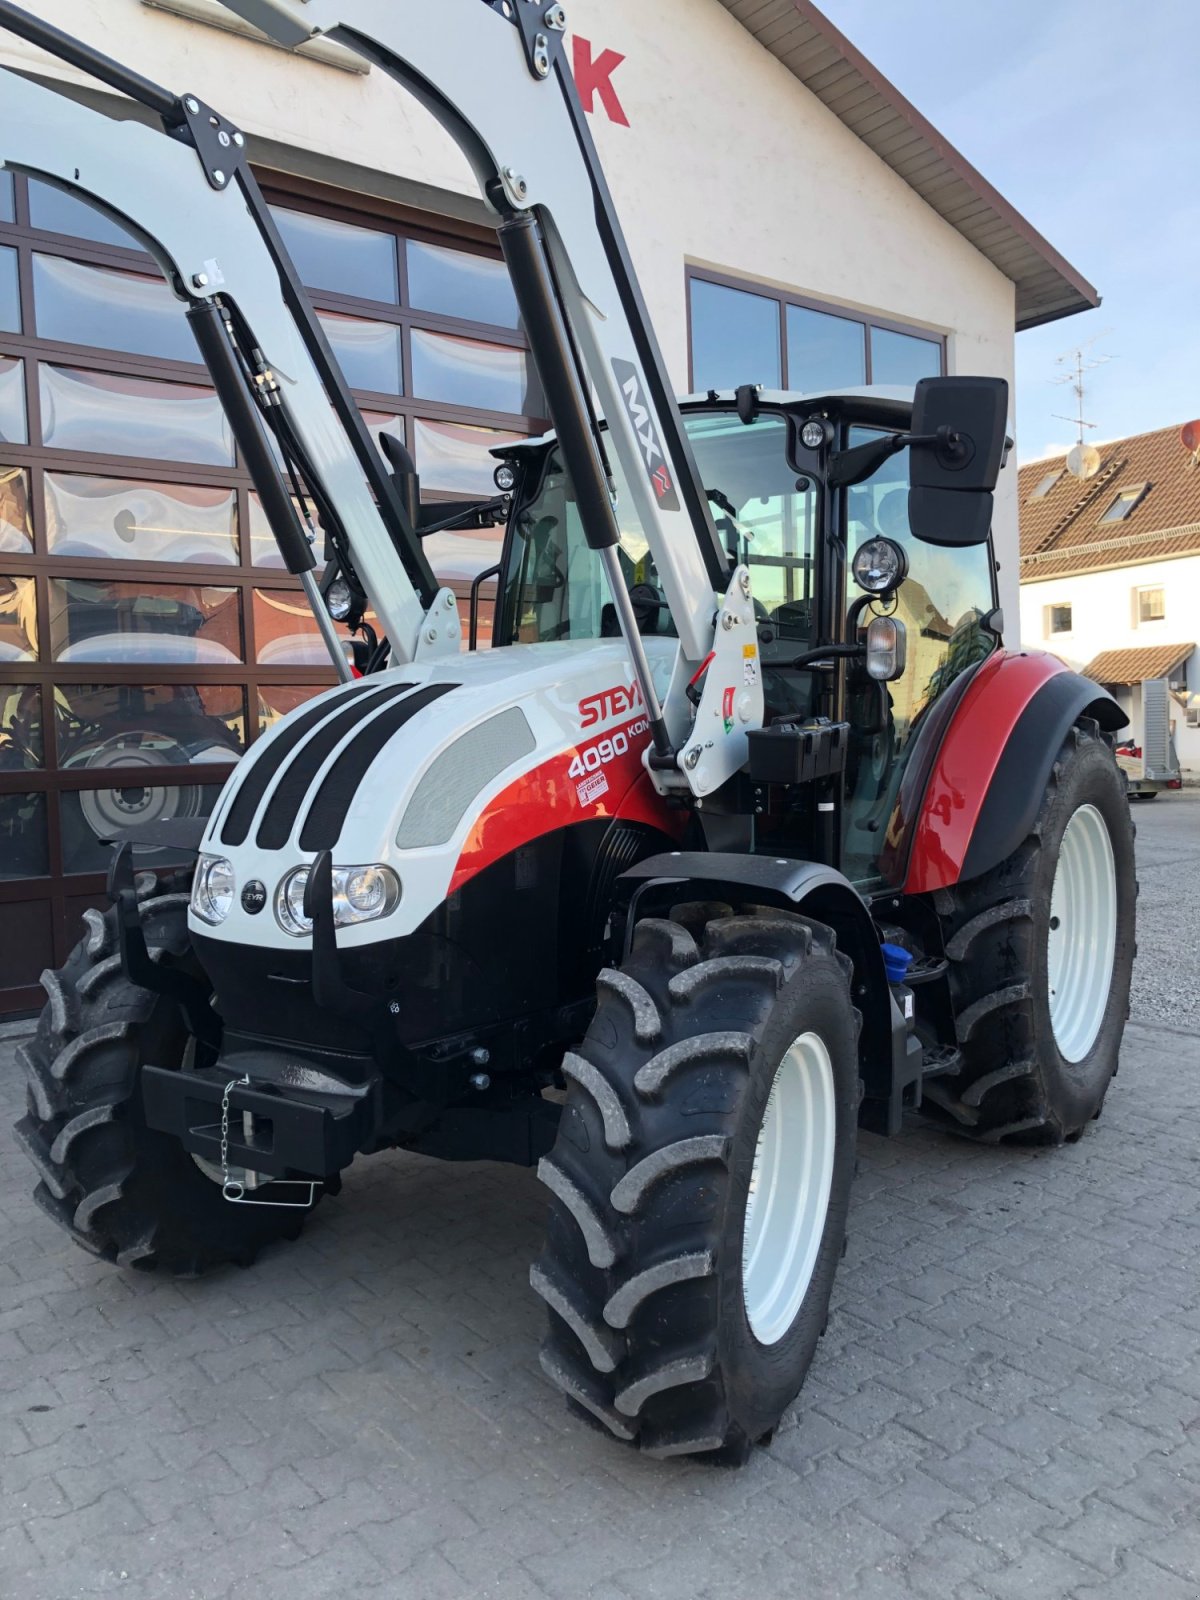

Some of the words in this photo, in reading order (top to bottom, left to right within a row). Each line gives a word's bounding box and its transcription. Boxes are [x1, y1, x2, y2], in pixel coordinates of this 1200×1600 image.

[572, 34, 630, 128] K
[622, 375, 662, 468] MX
[578, 679, 643, 728] STEY
[568, 731, 629, 778] 4090
[586, 775, 605, 791] GEIER
